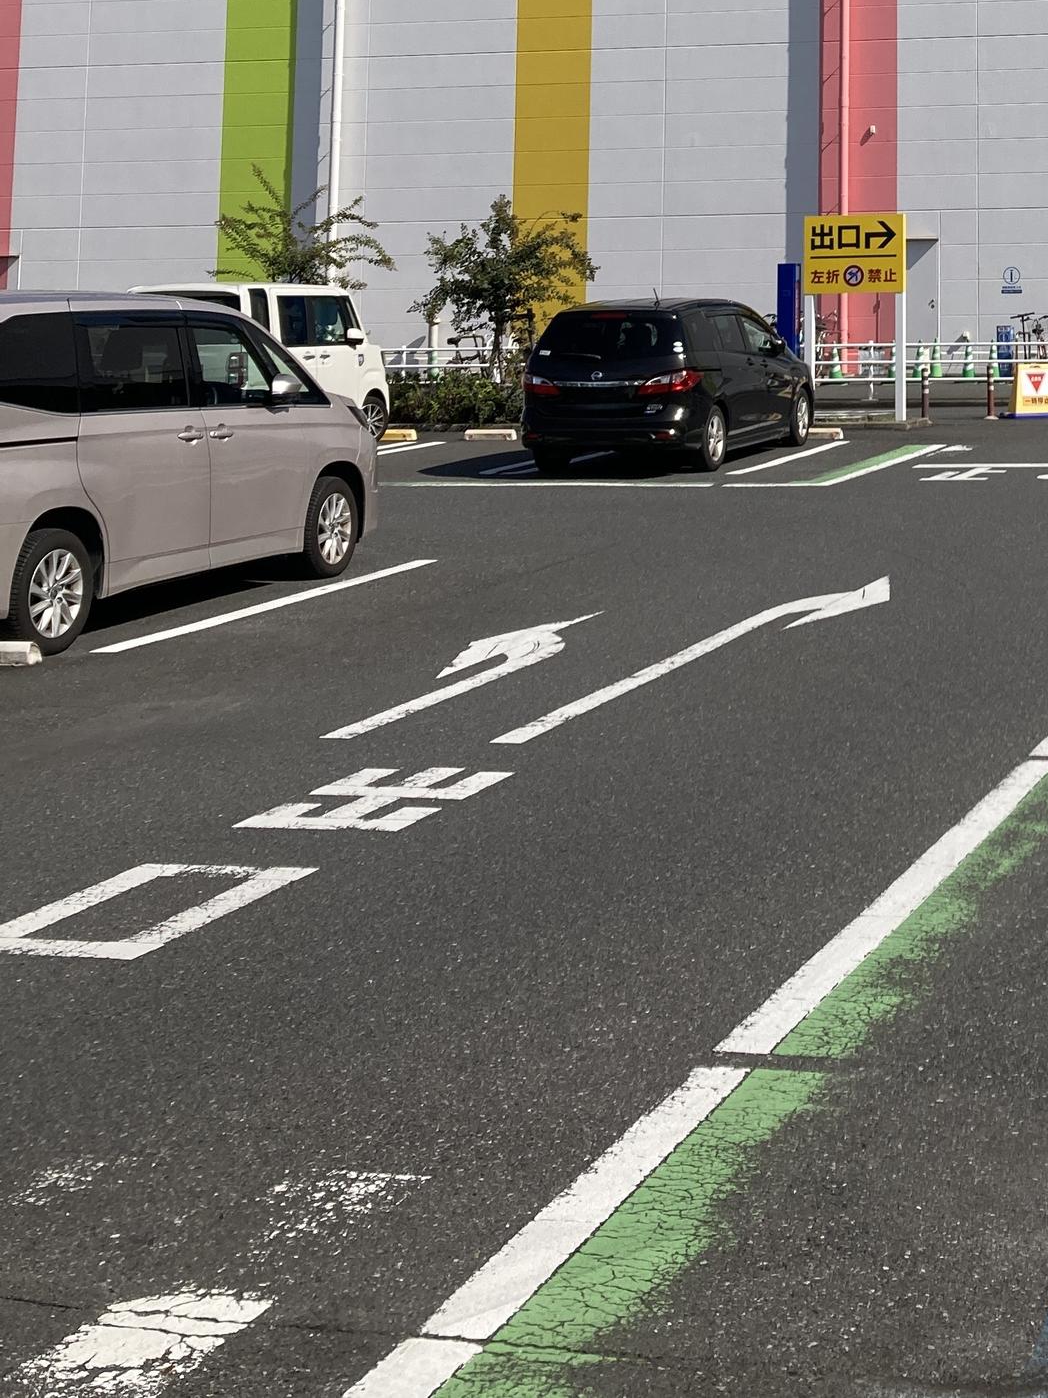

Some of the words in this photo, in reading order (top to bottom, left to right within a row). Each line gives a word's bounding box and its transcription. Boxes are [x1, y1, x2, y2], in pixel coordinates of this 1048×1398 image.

[810, 224, 861, 251] 出口
[810, 269, 840, 284] 左折
[867, 268, 898, 283] 禁止
